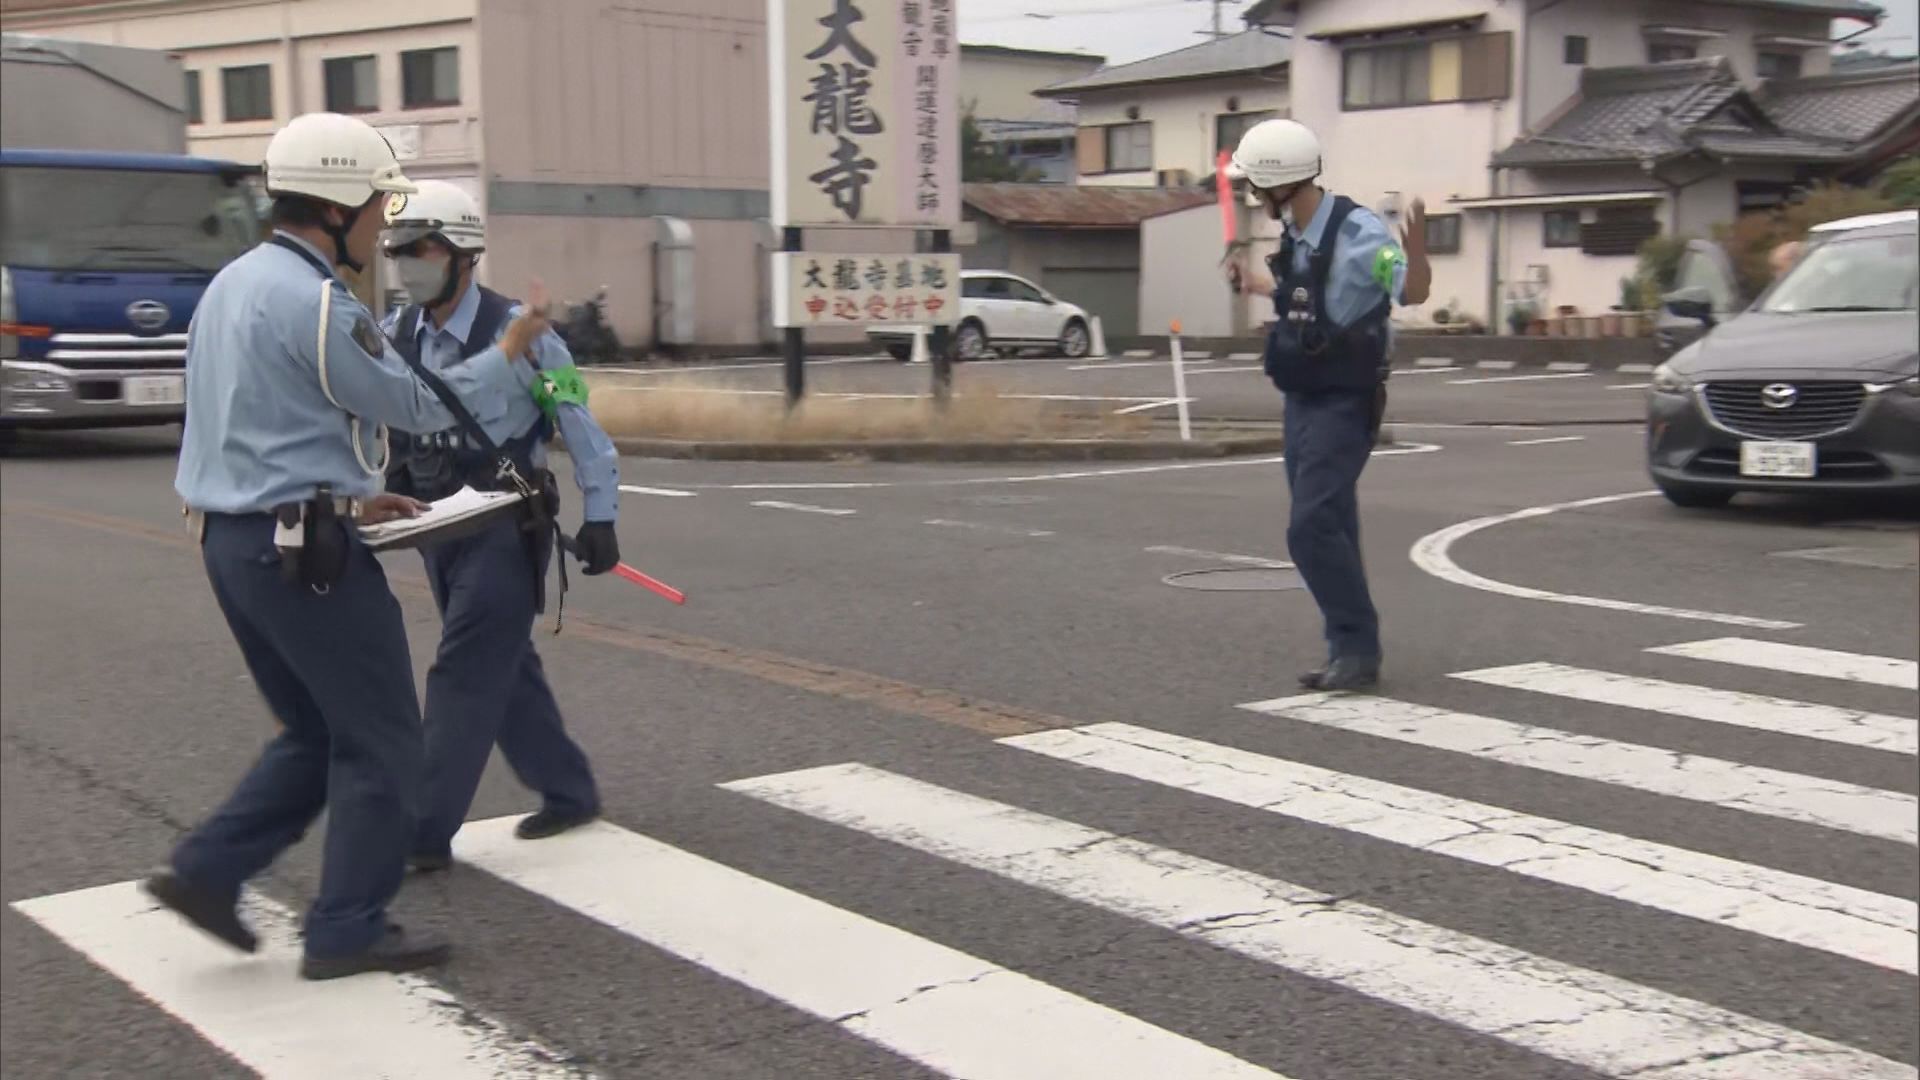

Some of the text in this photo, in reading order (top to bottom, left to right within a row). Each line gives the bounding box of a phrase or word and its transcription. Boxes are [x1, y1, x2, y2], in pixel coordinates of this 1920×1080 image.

[801, 0, 885, 220] 大龍寺
[802, 258, 948, 291] 大龍寺墓地
[803, 294, 946, 321] 申込受付中
